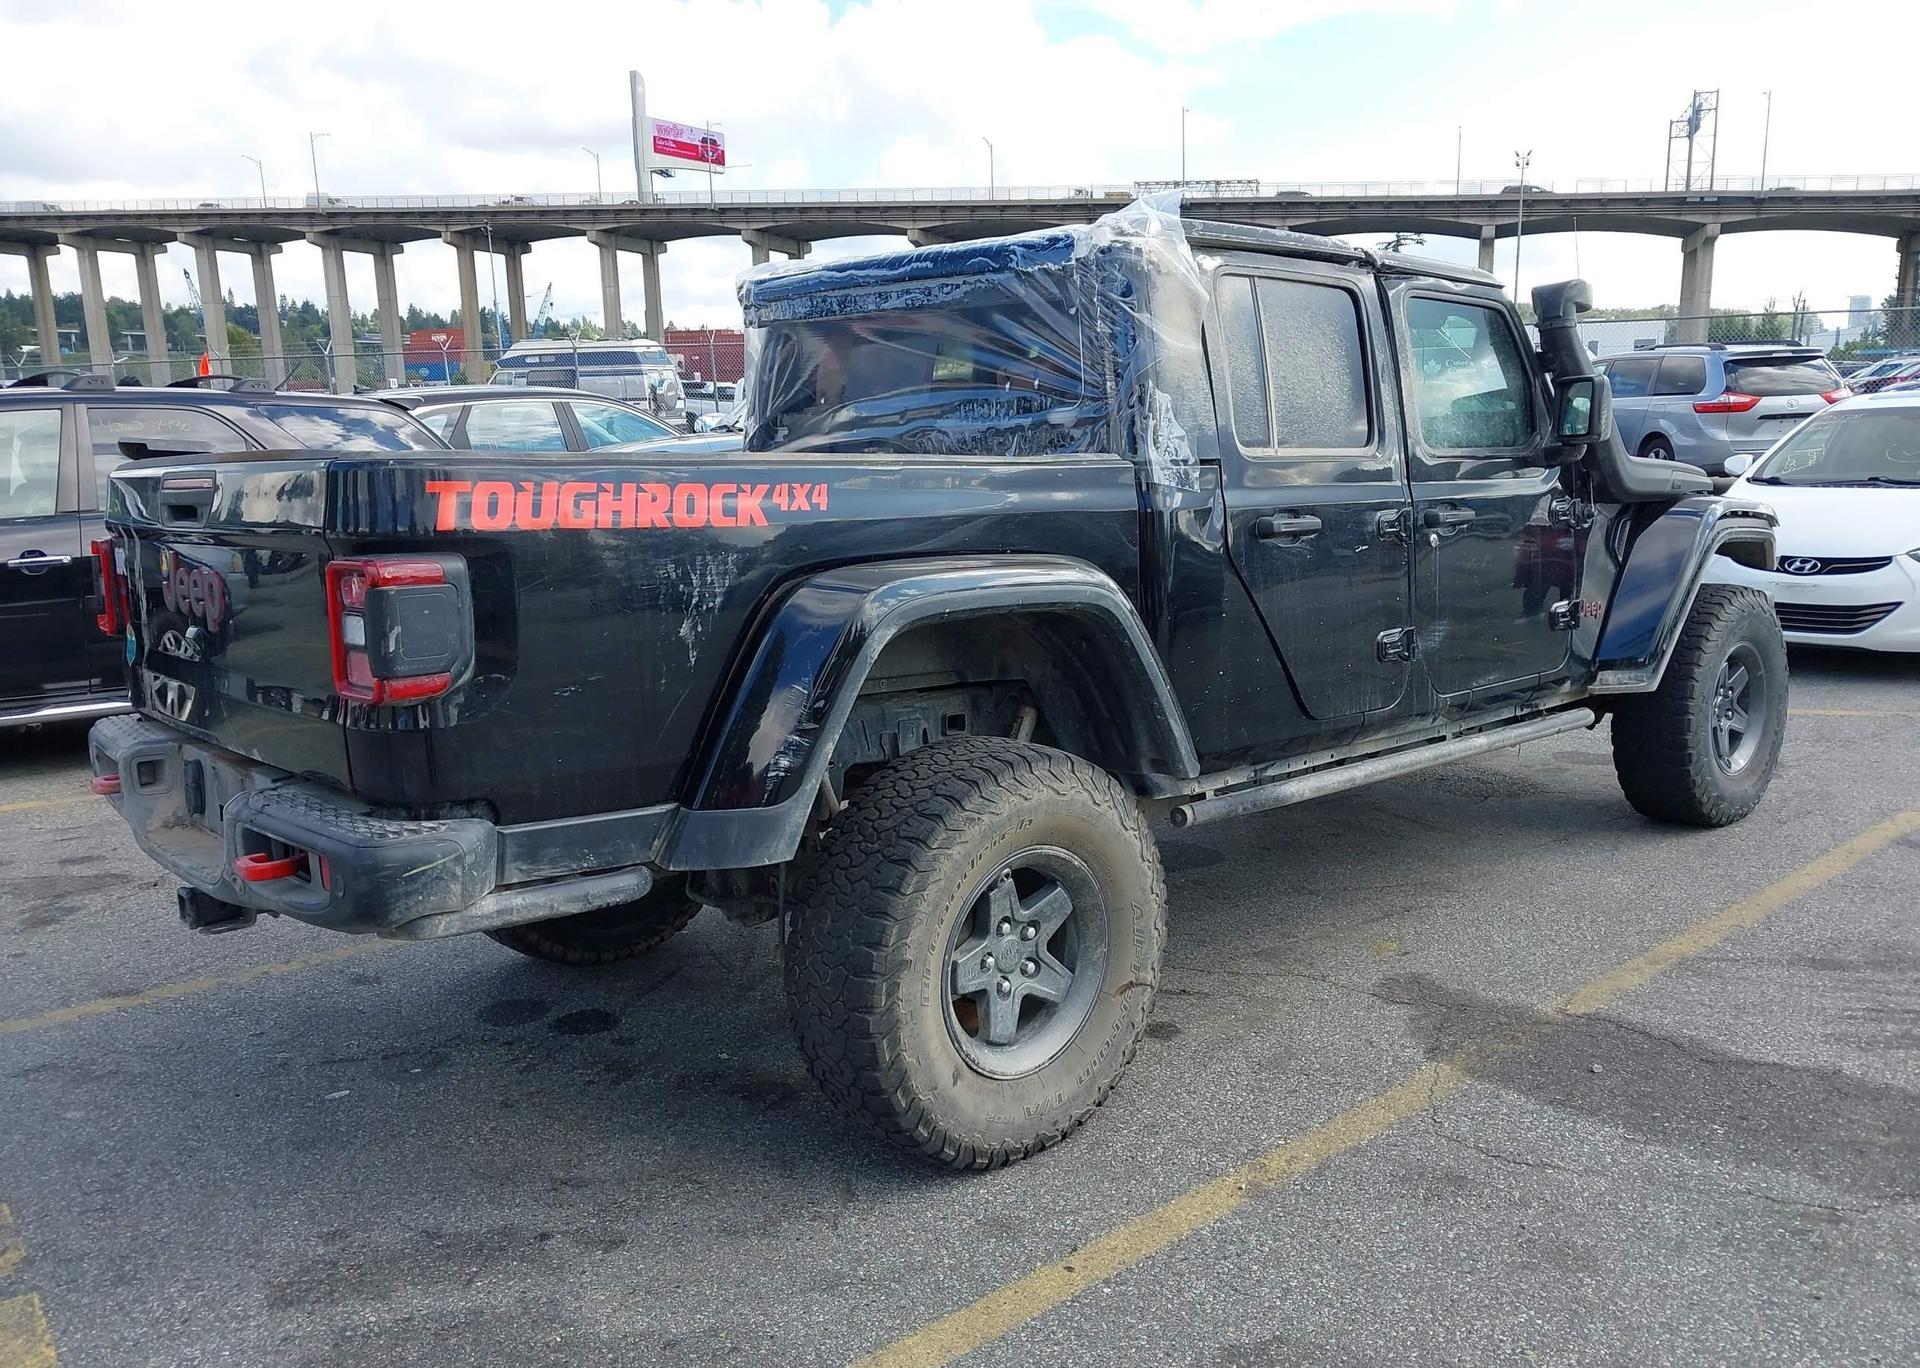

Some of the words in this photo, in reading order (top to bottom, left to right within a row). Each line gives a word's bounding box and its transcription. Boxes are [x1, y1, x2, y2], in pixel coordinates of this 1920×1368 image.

[425, 480, 771, 531] TOUGHROCK
[772, 483, 829, 512] 4X4
[162, 550, 226, 633] Jeep
[1579, 599, 1603, 619] Jeep
